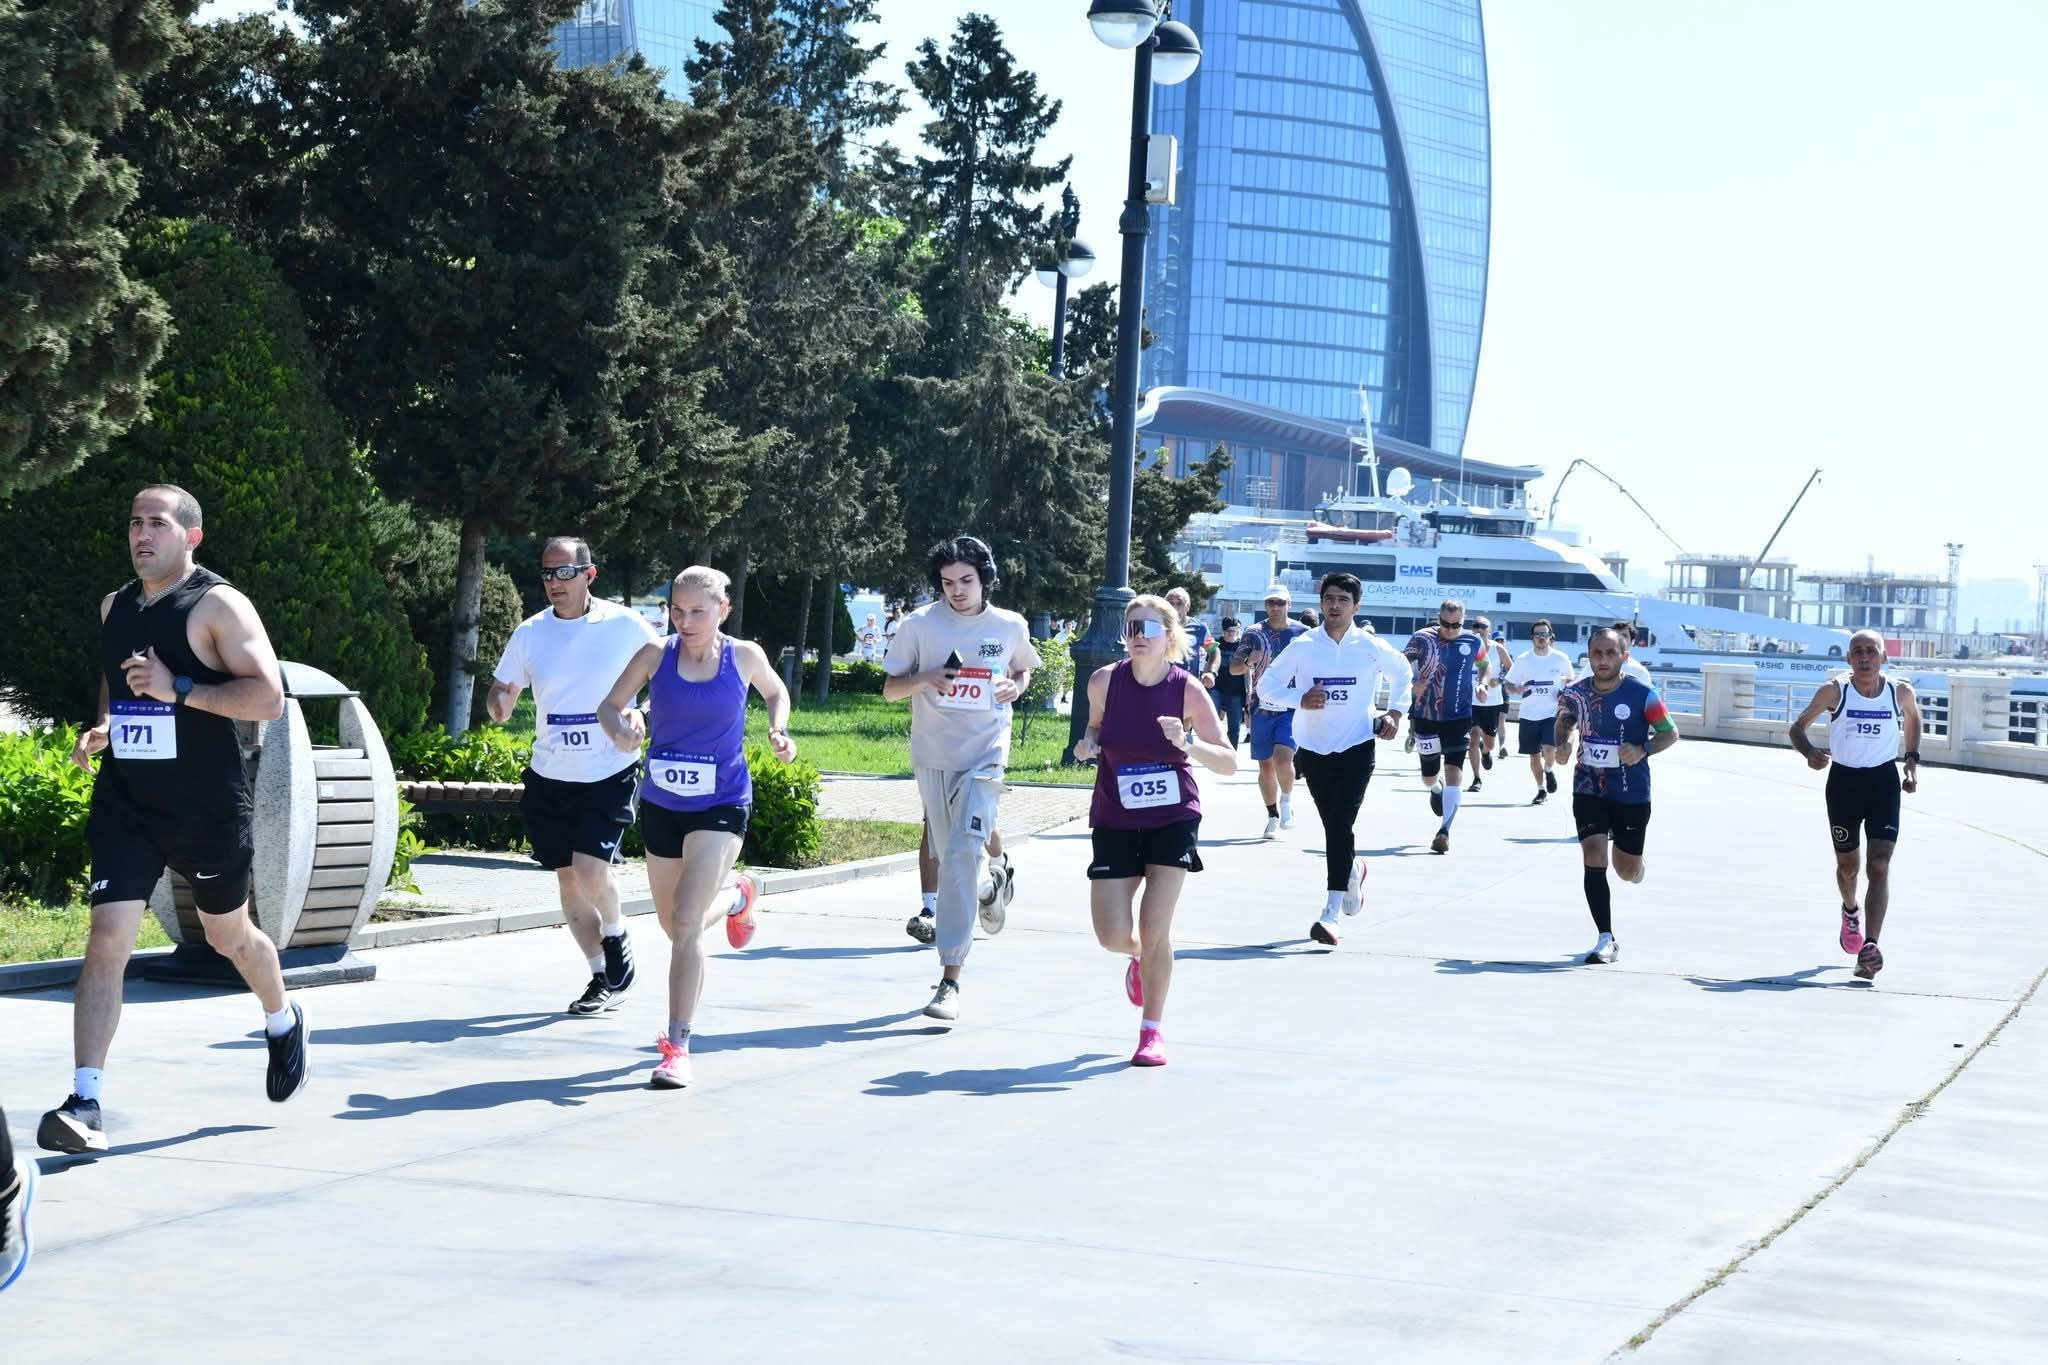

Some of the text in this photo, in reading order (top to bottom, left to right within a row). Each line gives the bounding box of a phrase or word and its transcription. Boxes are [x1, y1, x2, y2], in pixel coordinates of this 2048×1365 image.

[1399, 565, 1433, 577] CMS
[1367, 584, 1476, 598] CASPMARINE.COM
[1755, 661, 1784, 669] RASHID
[1535, 687, 1549, 695] 193
[120, 724, 153, 745] 171
[1856, 723, 1881, 735] 195
[560, 731, 589, 746] 101
[664, 768, 700, 785] 013
[1130, 779, 1168, 798] 035
